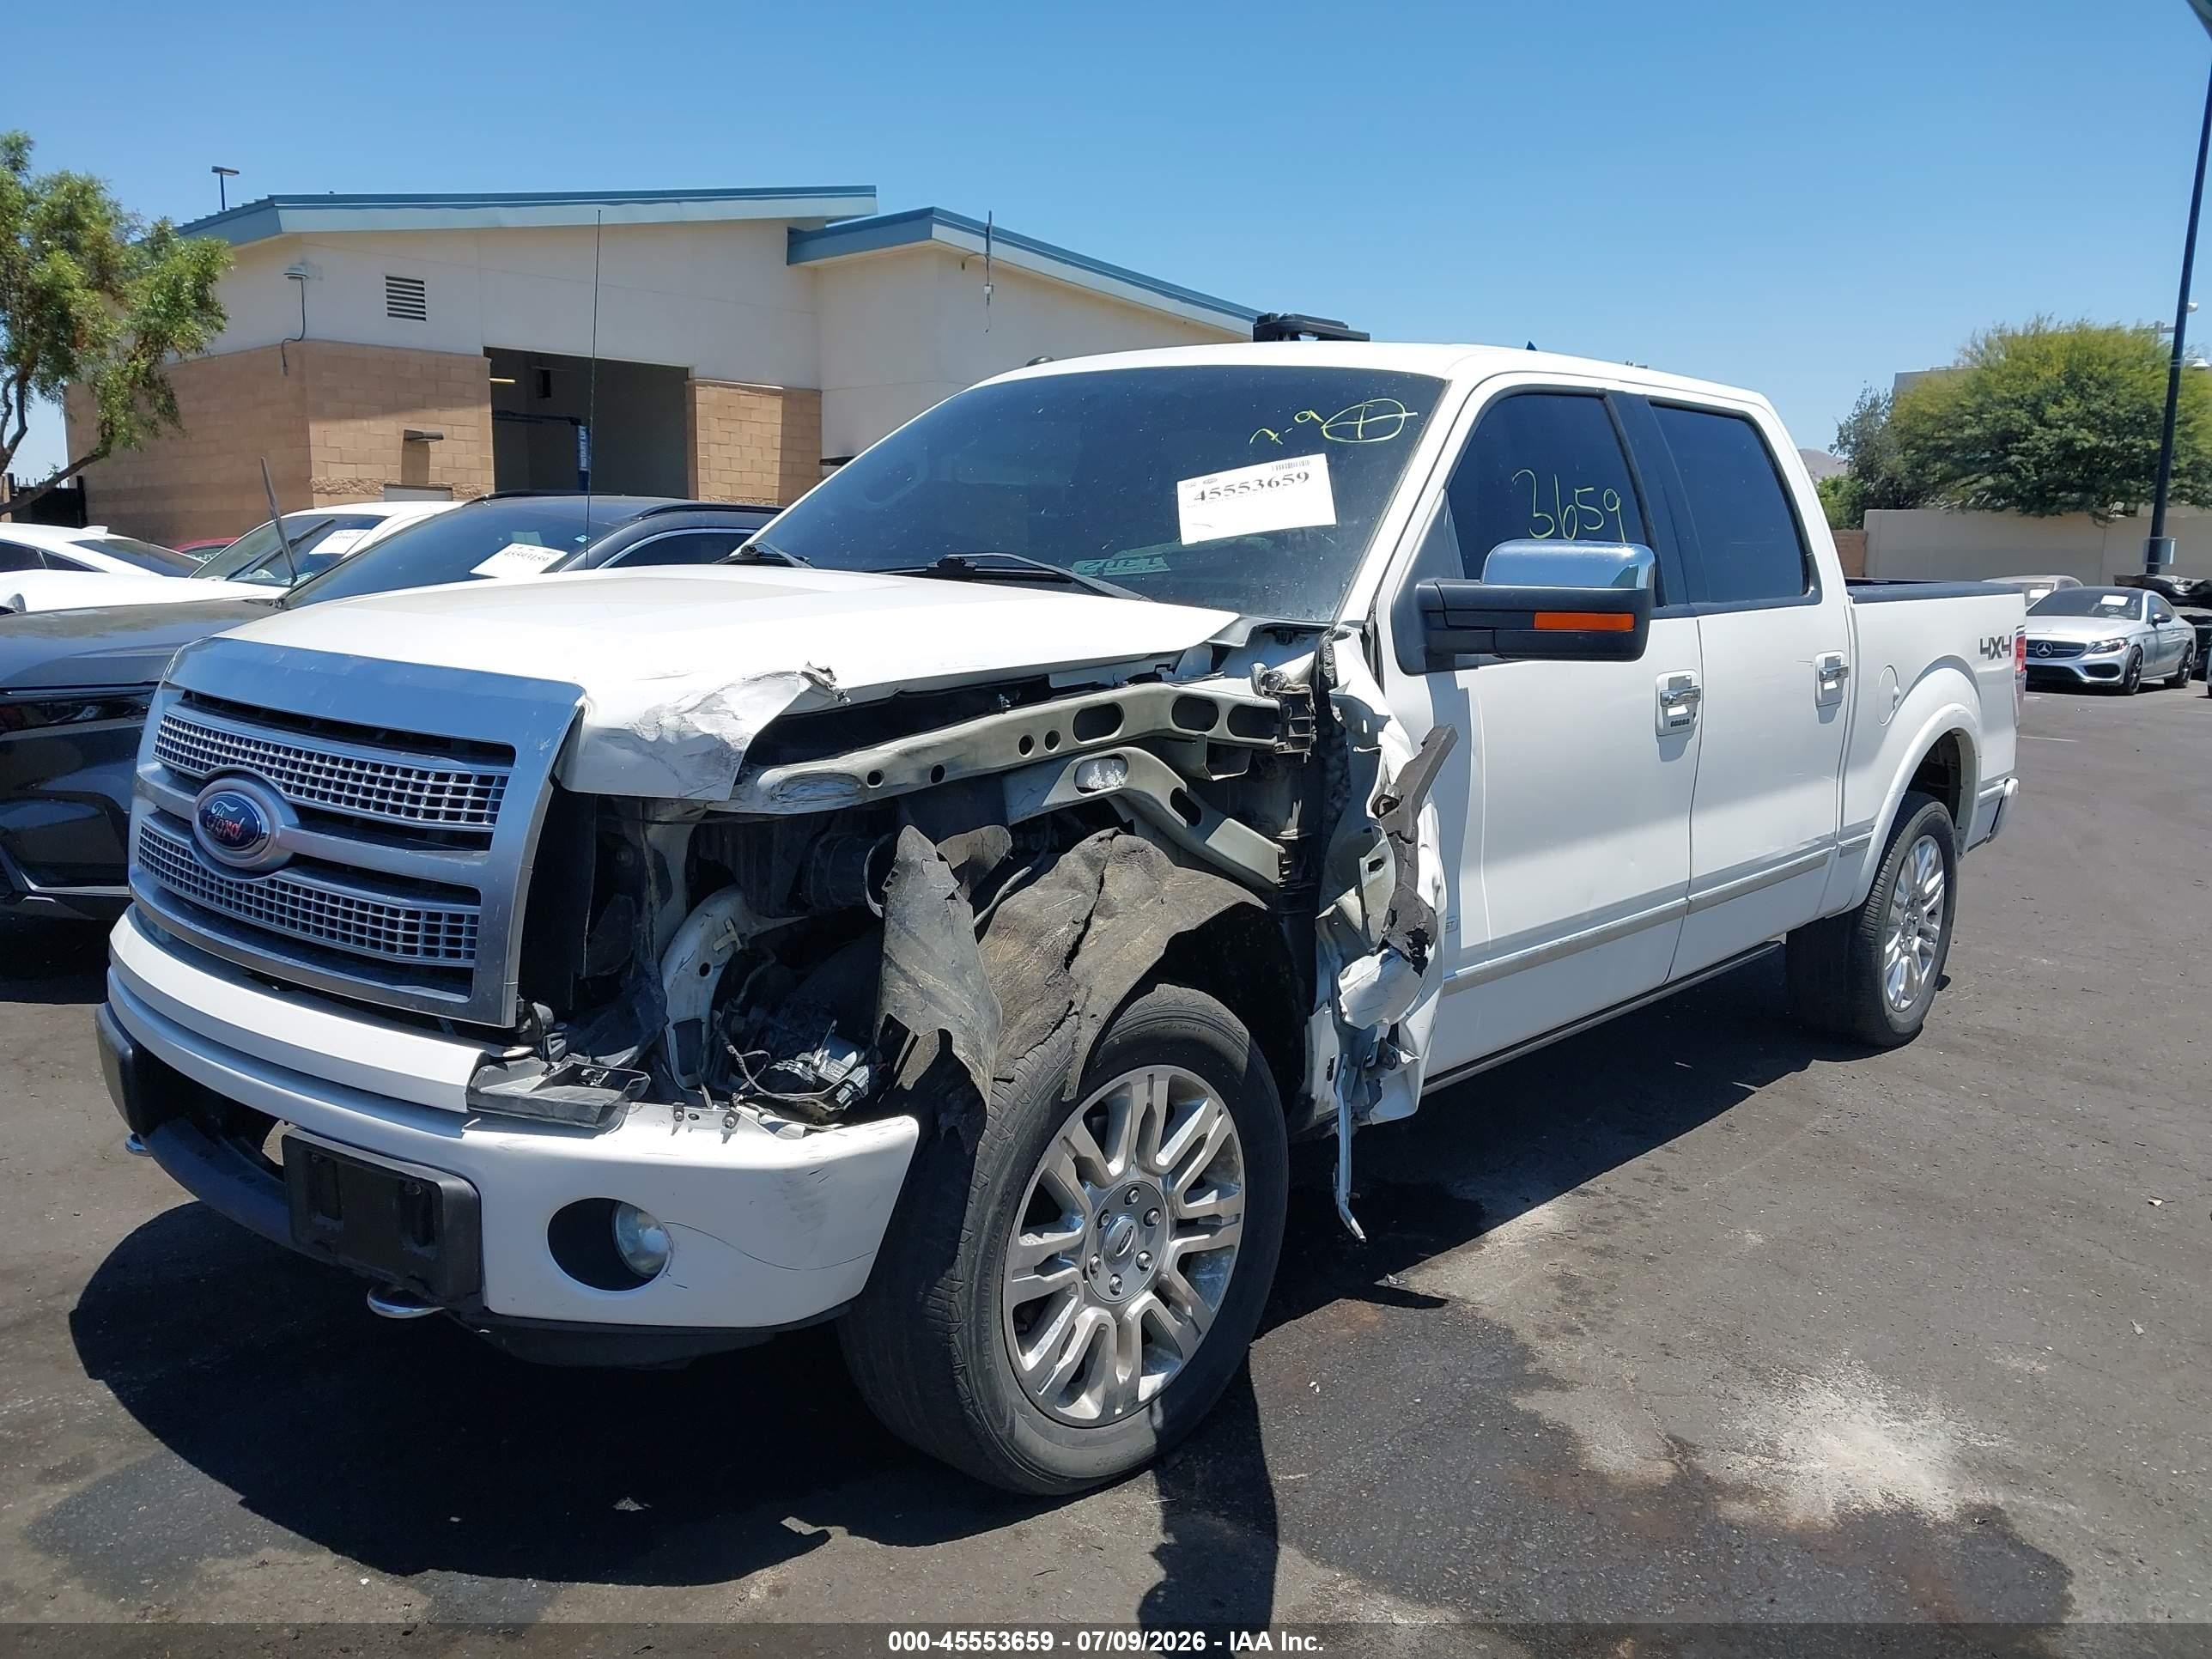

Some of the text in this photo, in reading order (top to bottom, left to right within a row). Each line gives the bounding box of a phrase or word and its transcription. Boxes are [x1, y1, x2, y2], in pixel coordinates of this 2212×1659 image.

[1194, 471, 1310, 501] 45553659
[1512, 469, 1626, 543] 3659
[207, 800, 246, 840] Ford
